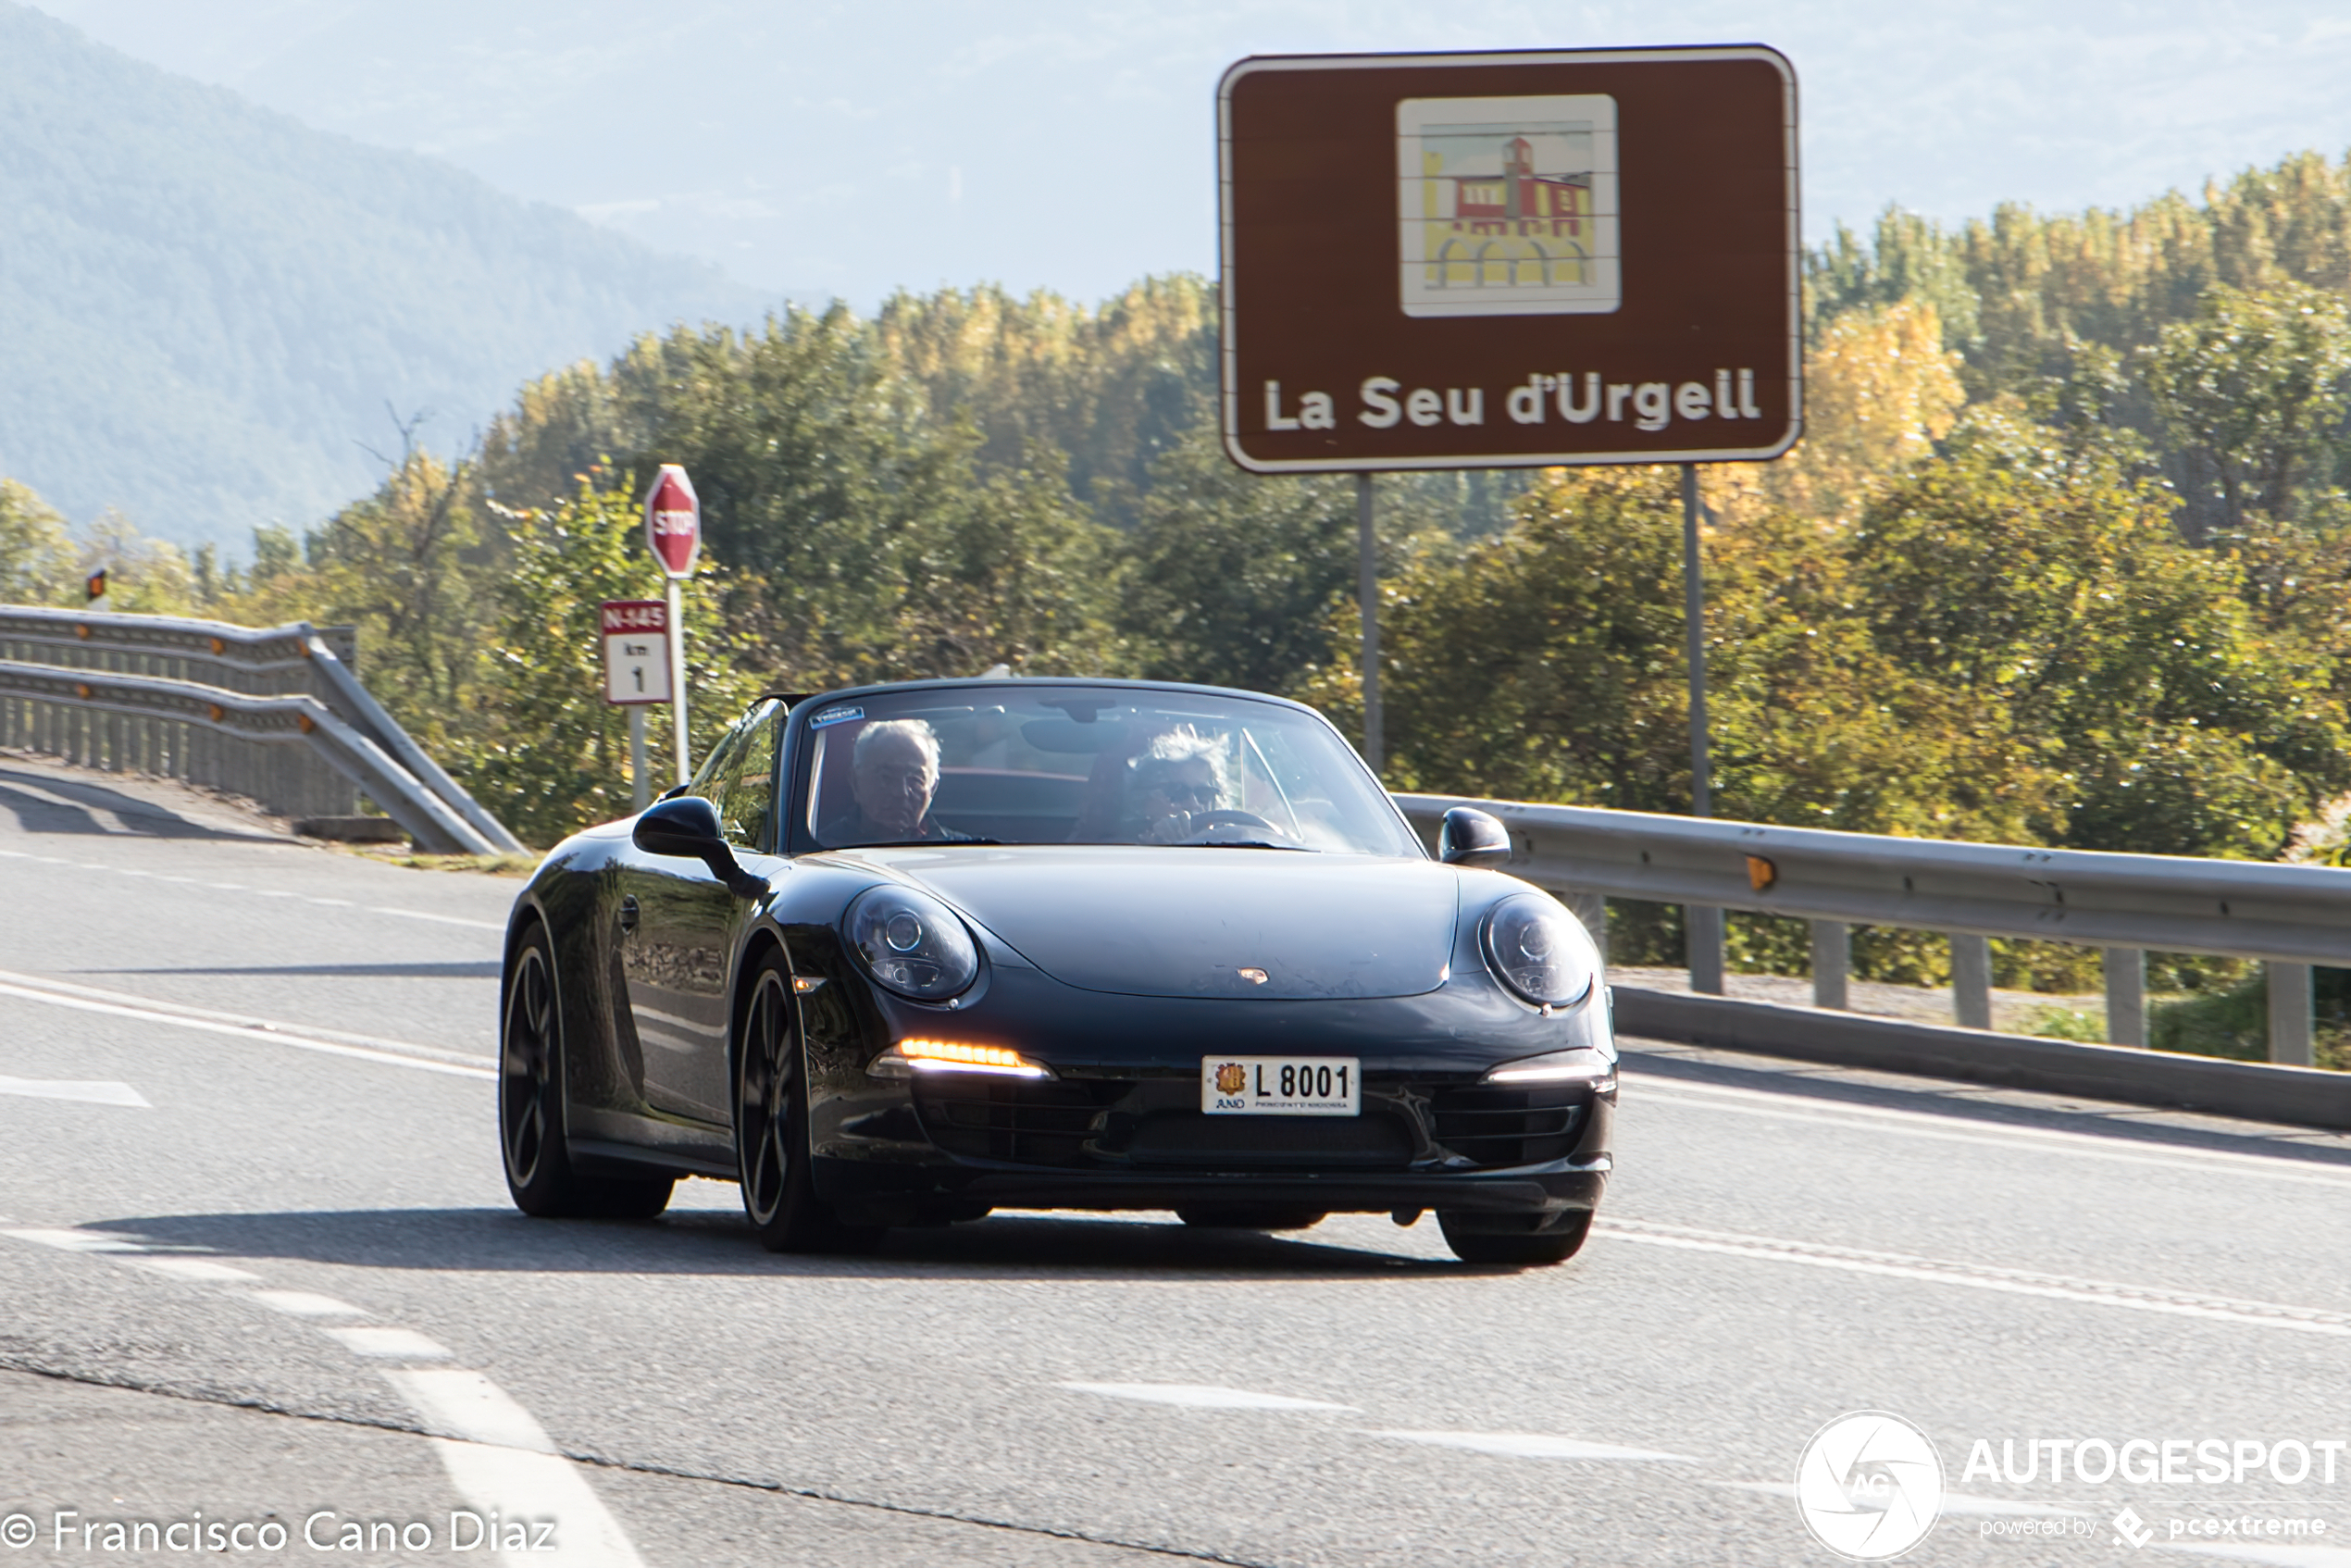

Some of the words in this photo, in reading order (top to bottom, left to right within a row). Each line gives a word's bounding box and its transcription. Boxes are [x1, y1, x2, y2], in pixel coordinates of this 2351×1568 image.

[1265, 380, 1335, 430] La
[1358, 377, 1484, 428] Seu
[1507, 368, 1761, 431] d'Urgell
[653, 511, 694, 536] STOP
[631, 666, 643, 692] 1
[1256, 1064, 1271, 1097] L
[1280, 1064, 1348, 1099] 8001
[1216, 1099, 1245, 1109] AND
